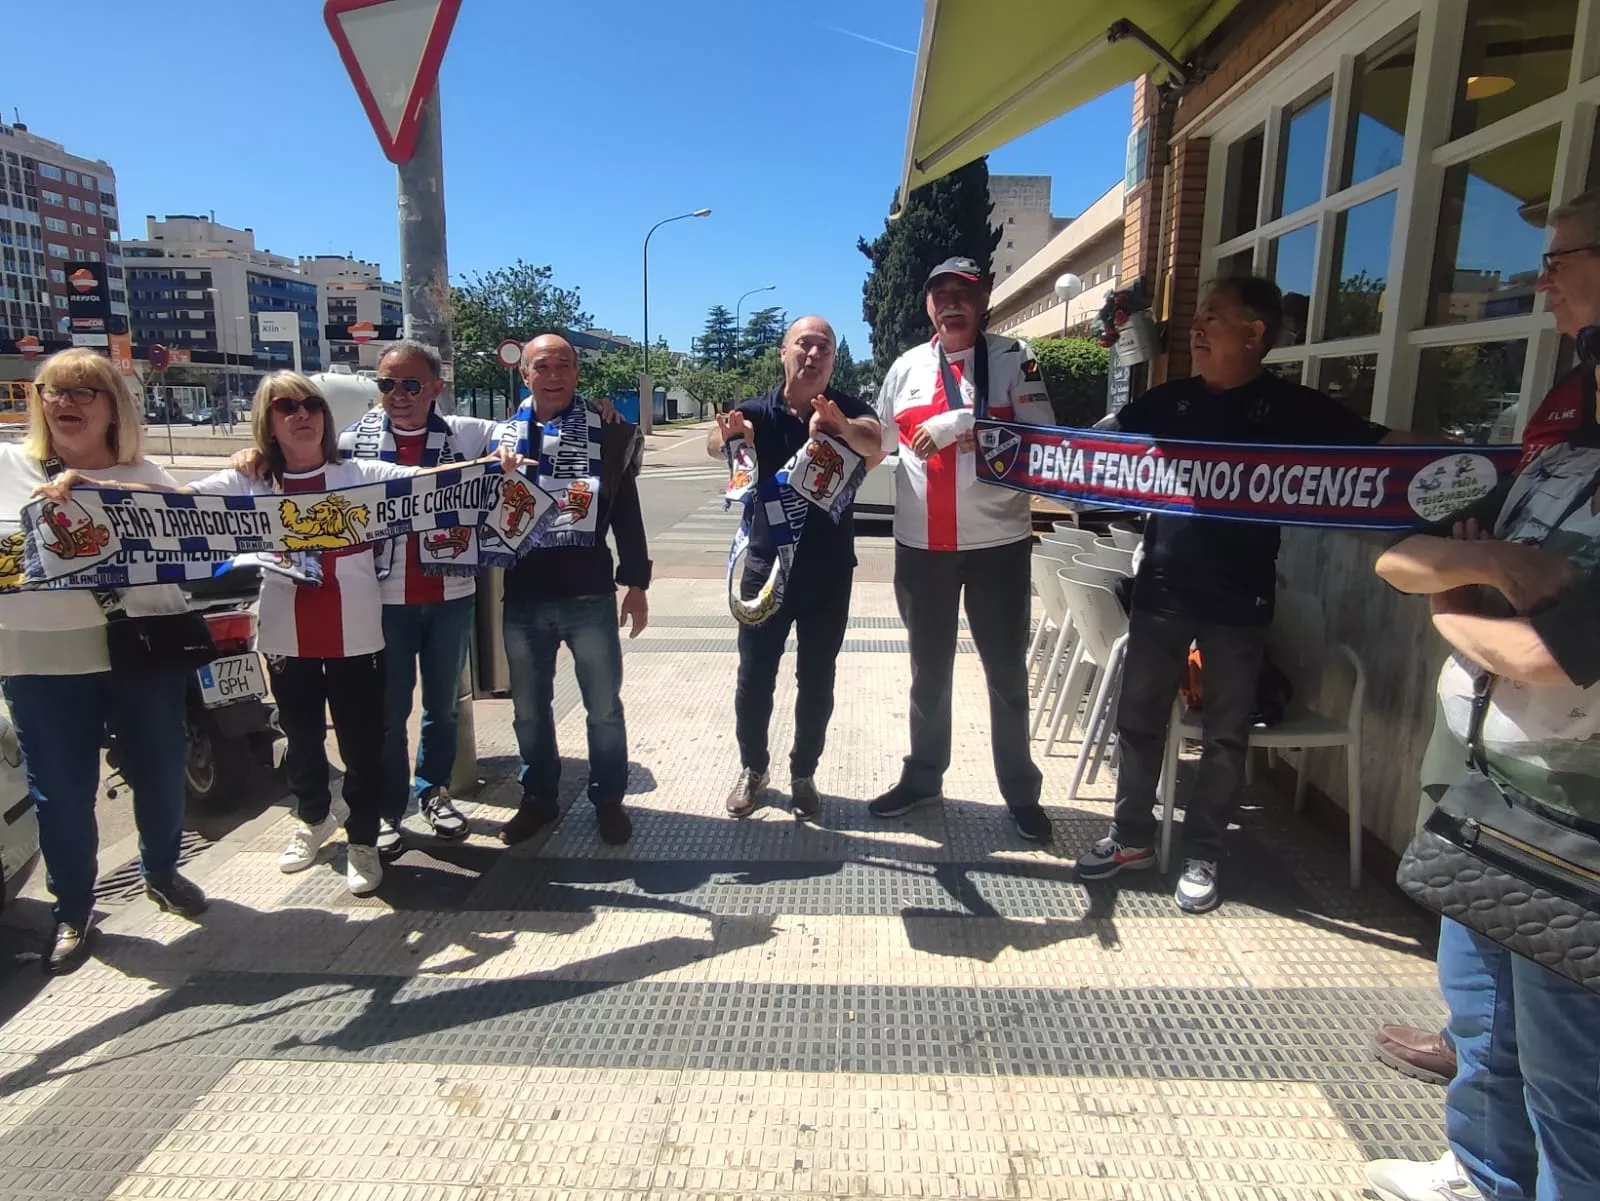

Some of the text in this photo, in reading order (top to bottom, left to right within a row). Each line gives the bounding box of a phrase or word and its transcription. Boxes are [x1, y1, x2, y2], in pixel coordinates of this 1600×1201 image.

[262, 324, 280, 333] Klin
[1028, 439, 1086, 485] PEÑA
[1090, 446, 1245, 502] FENÓMENOS
[1249, 463, 1390, 509] OSCENSES
[376, 476, 504, 523] AS DE CORAZONES
[102, 500, 272, 538] PEÑA ZARAGOCISTA
[215, 658, 254, 679] 7774
[219, 676, 249, 696] GPH
